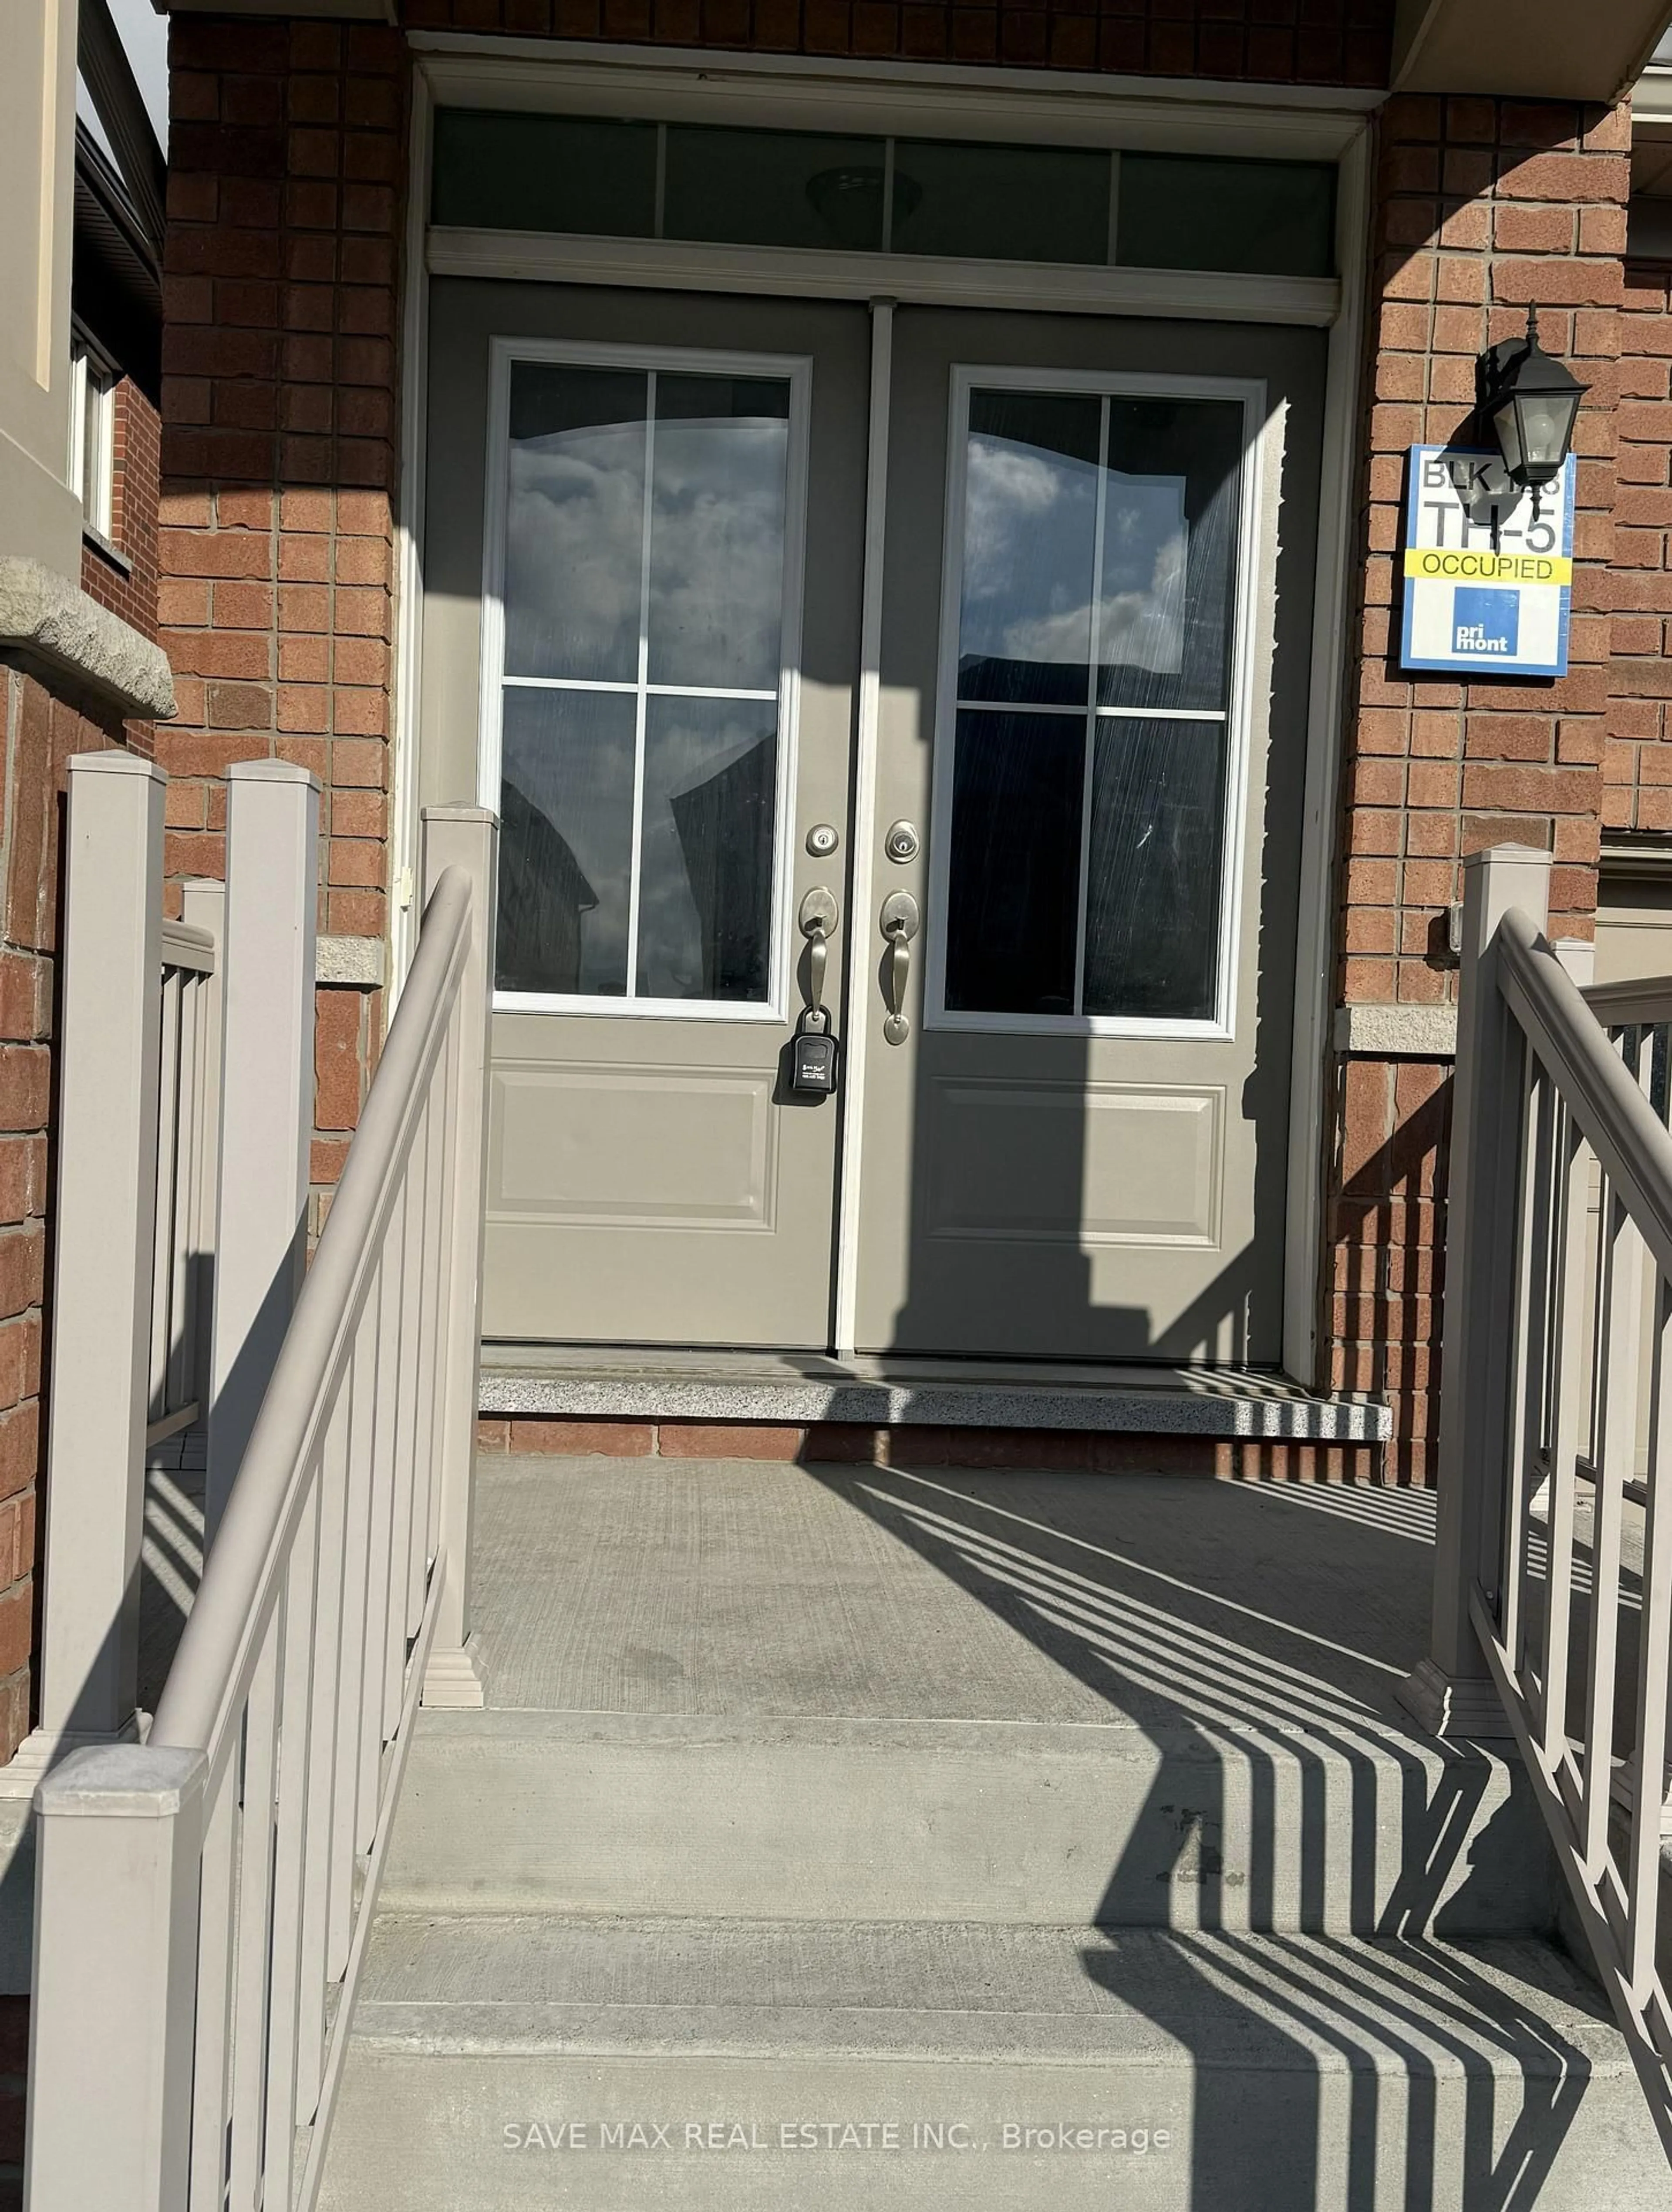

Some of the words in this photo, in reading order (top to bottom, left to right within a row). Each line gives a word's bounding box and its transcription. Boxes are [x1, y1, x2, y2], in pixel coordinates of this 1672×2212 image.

[1423, 460, 1492, 491] BLK
[1424, 501, 1555, 553] TH-5
[1423, 554, 1553, 579] OCCUPIED
[1456, 624, 1484, 639] pri
[1456, 636, 1507, 652] mont
